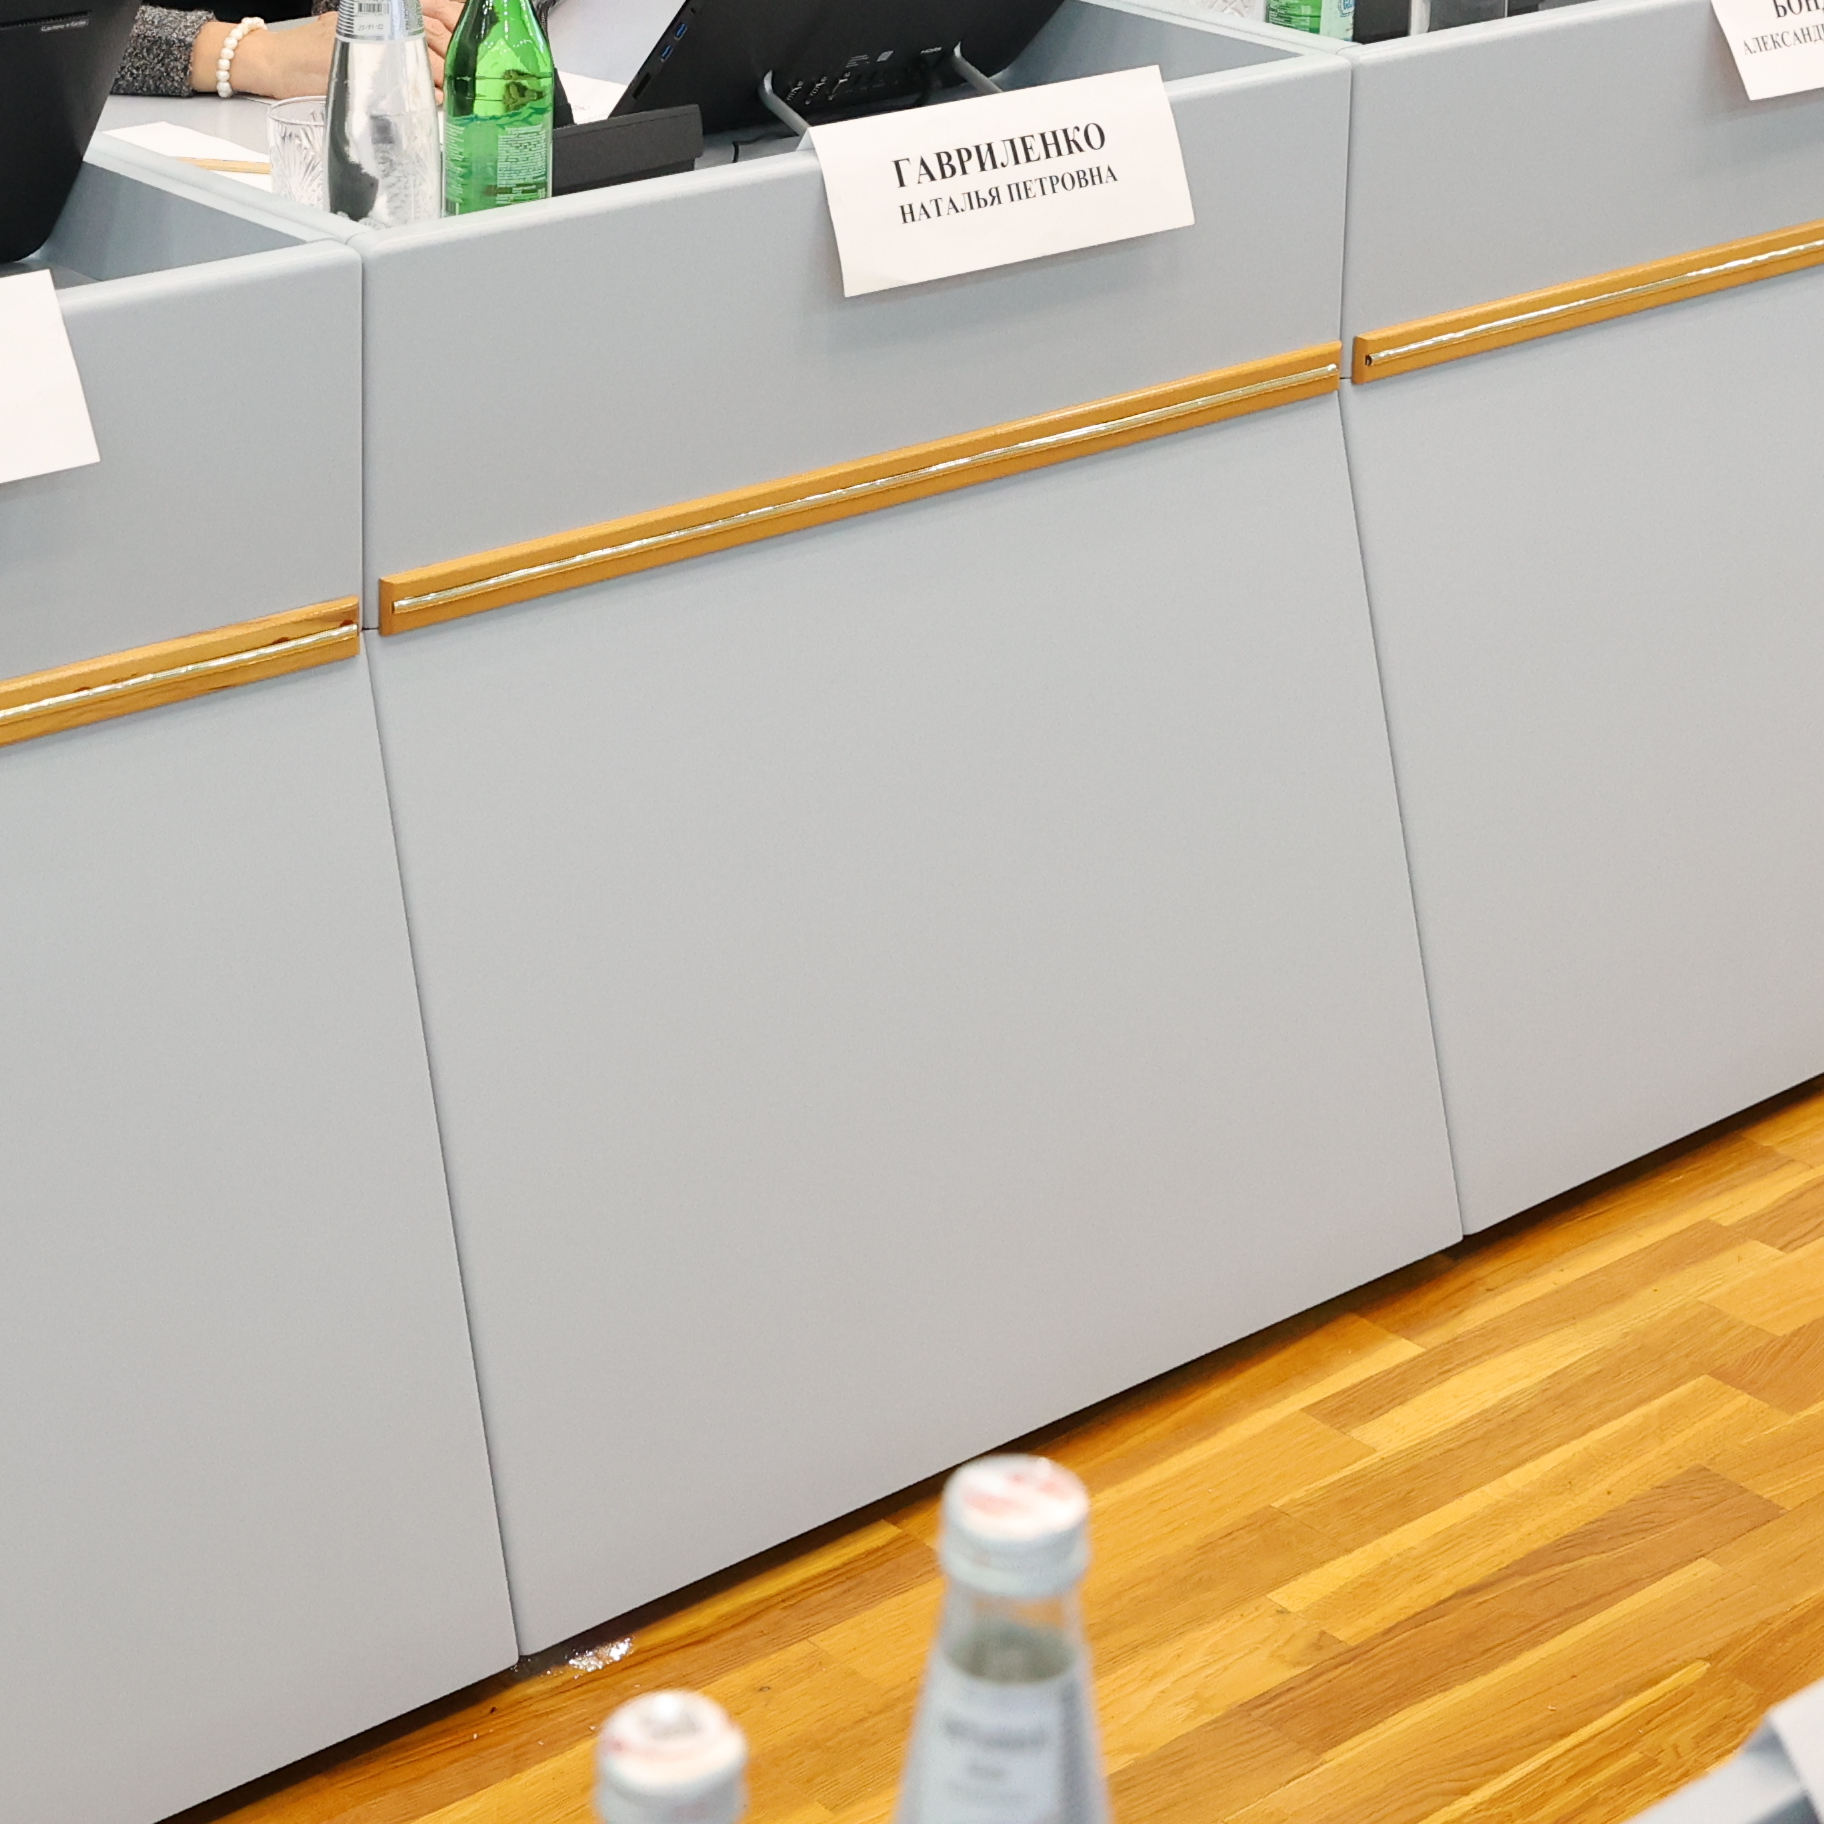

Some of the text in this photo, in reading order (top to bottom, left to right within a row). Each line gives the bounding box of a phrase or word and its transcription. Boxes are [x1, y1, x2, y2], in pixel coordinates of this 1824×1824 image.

[892, 122, 1106, 188] ГАВРИЛЕНКО
[900, 164, 1118, 224] НАТАЛЬЯ ПЕТРОВНА
